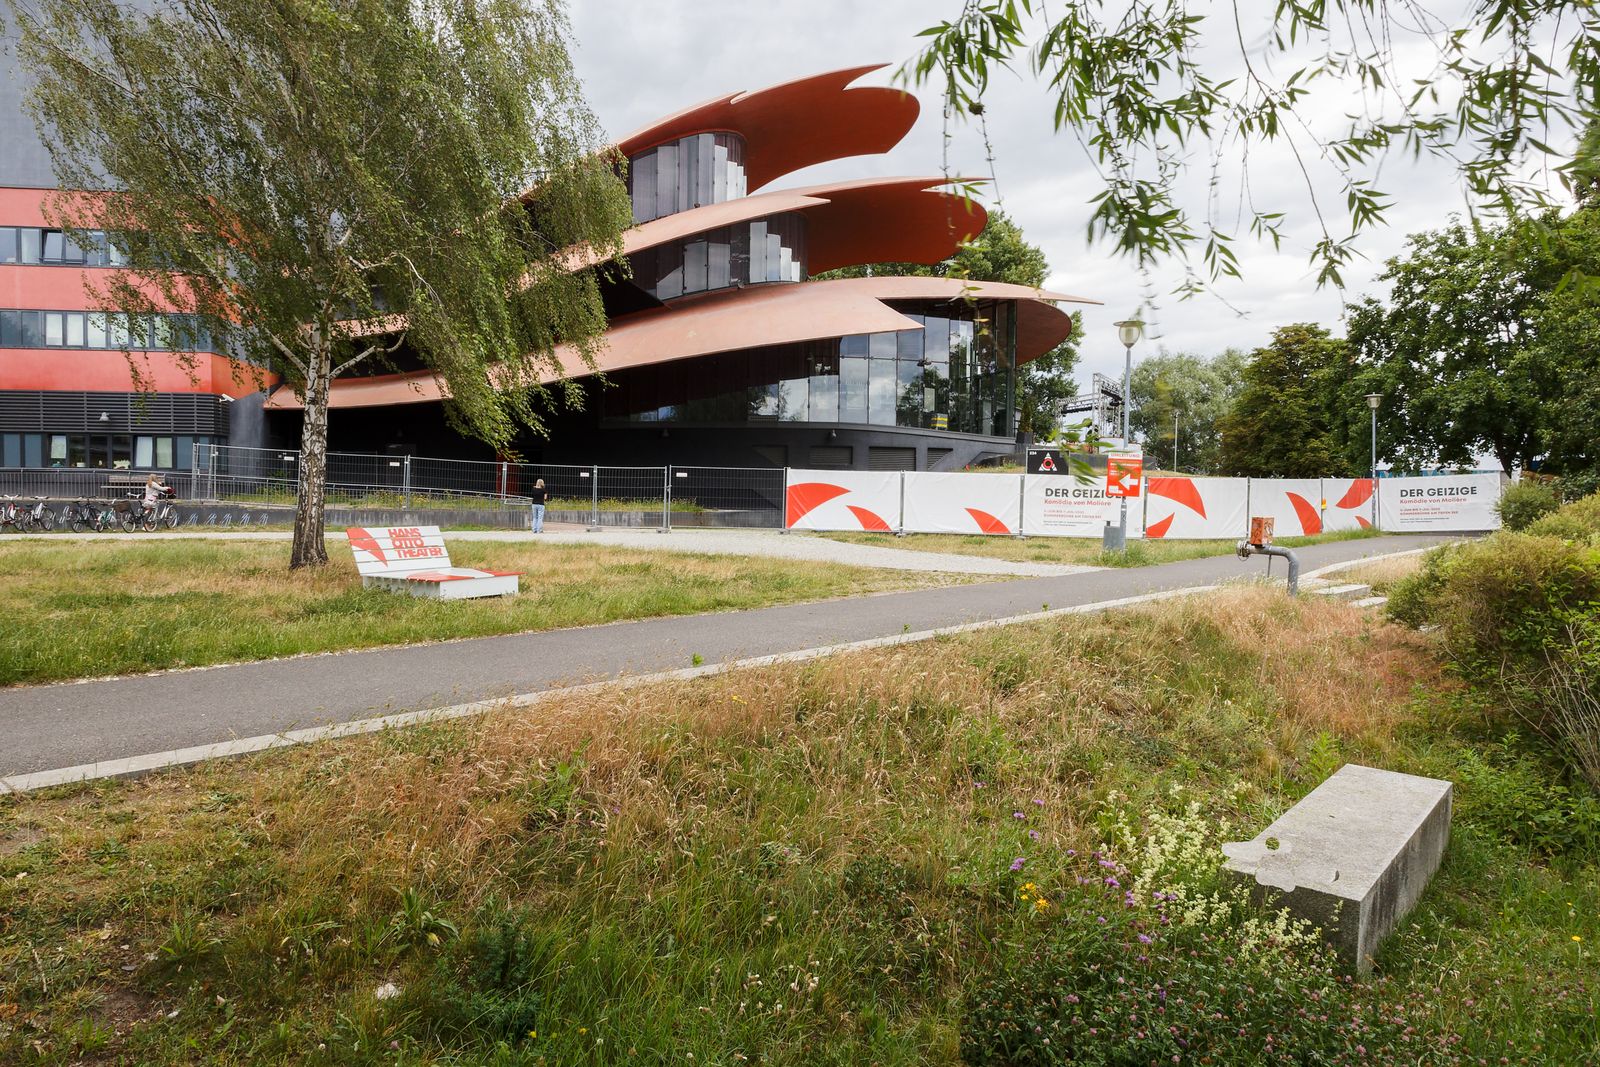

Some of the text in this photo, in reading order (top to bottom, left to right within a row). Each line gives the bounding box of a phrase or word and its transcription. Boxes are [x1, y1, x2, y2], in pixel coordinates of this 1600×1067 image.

[1045, 488, 1069, 498] DER
[1072, 488, 1122, 499] GEIZI
[1400, 486, 1477, 497] DER GEIZIGE
[388, 528, 421, 537] HANS
[392, 537, 424, 548] OTTO
[395, 548, 443, 558] THEATER
